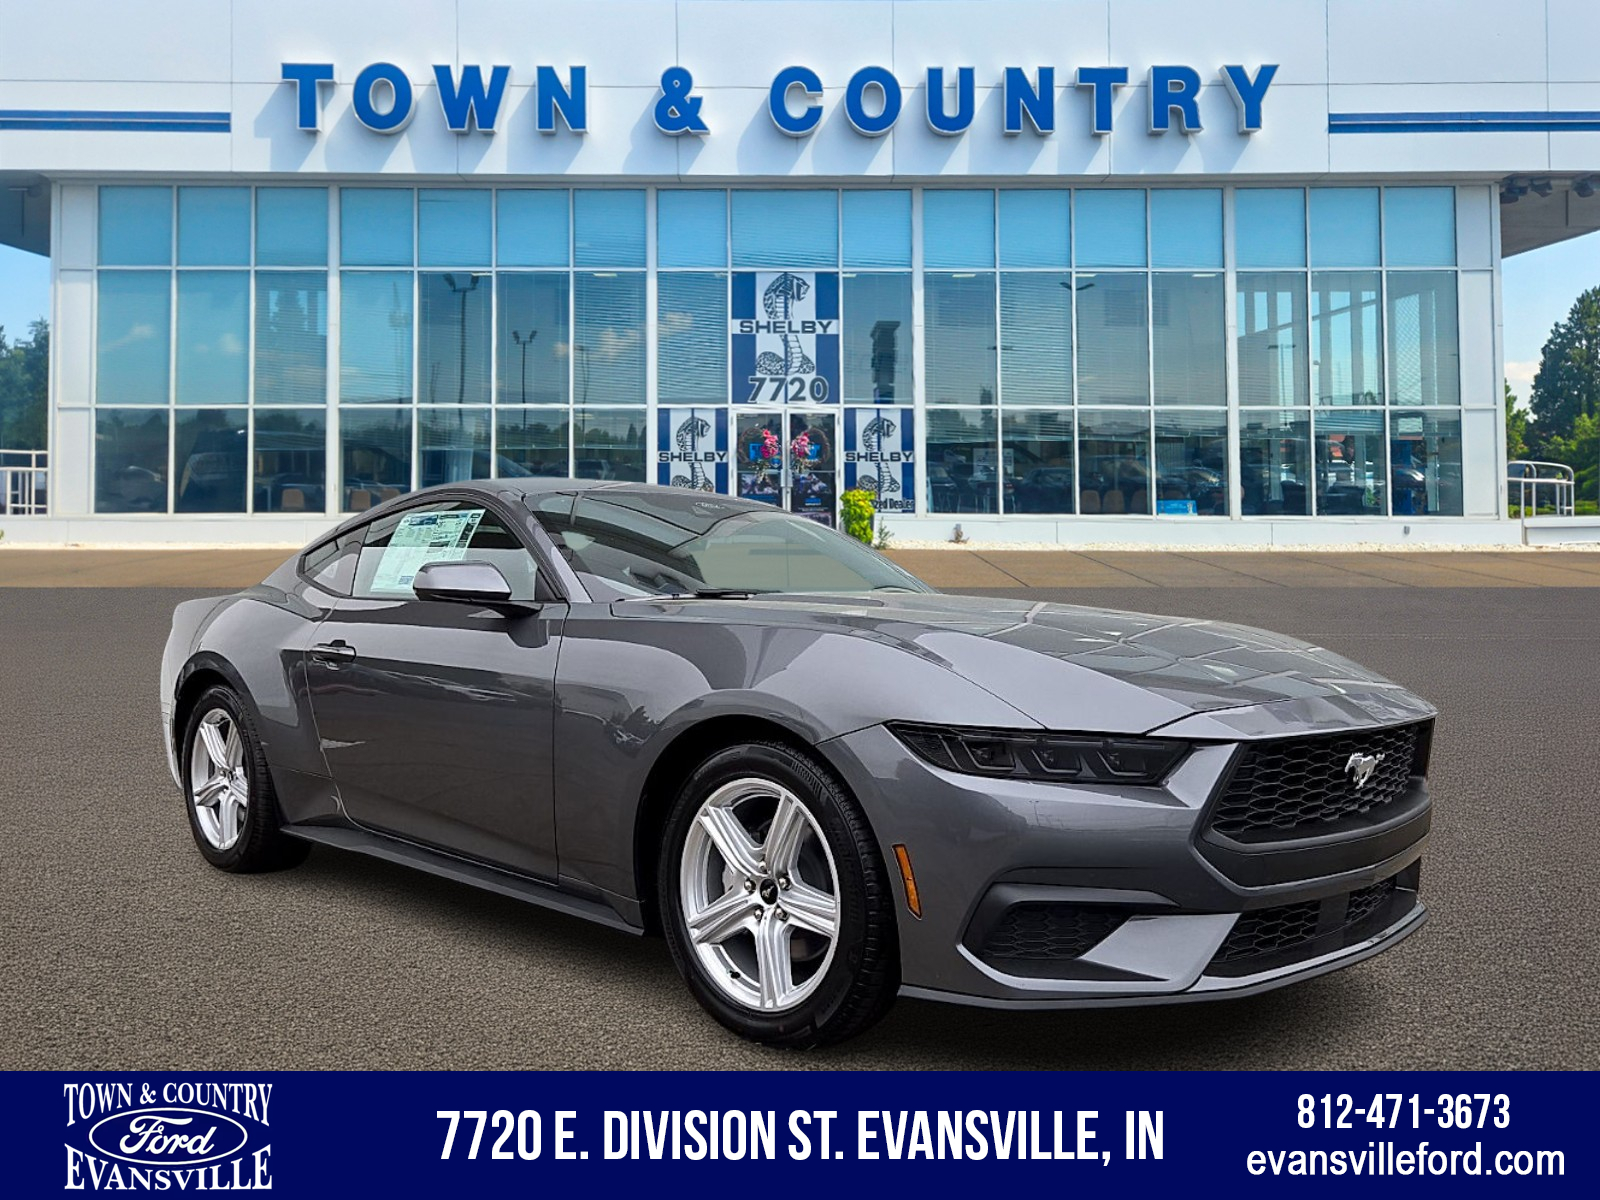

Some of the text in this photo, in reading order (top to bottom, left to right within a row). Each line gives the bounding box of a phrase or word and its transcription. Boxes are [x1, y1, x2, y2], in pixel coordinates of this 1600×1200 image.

[281, 62, 1279, 137] TOWN & COUNTRY
[740, 320, 832, 334] SHELBY
[748, 376, 828, 403] 7720
[659, 451, 727, 462] SHELBY
[845, 451, 913, 462] SHELBY
[889, 497, 914, 510] Dealer
